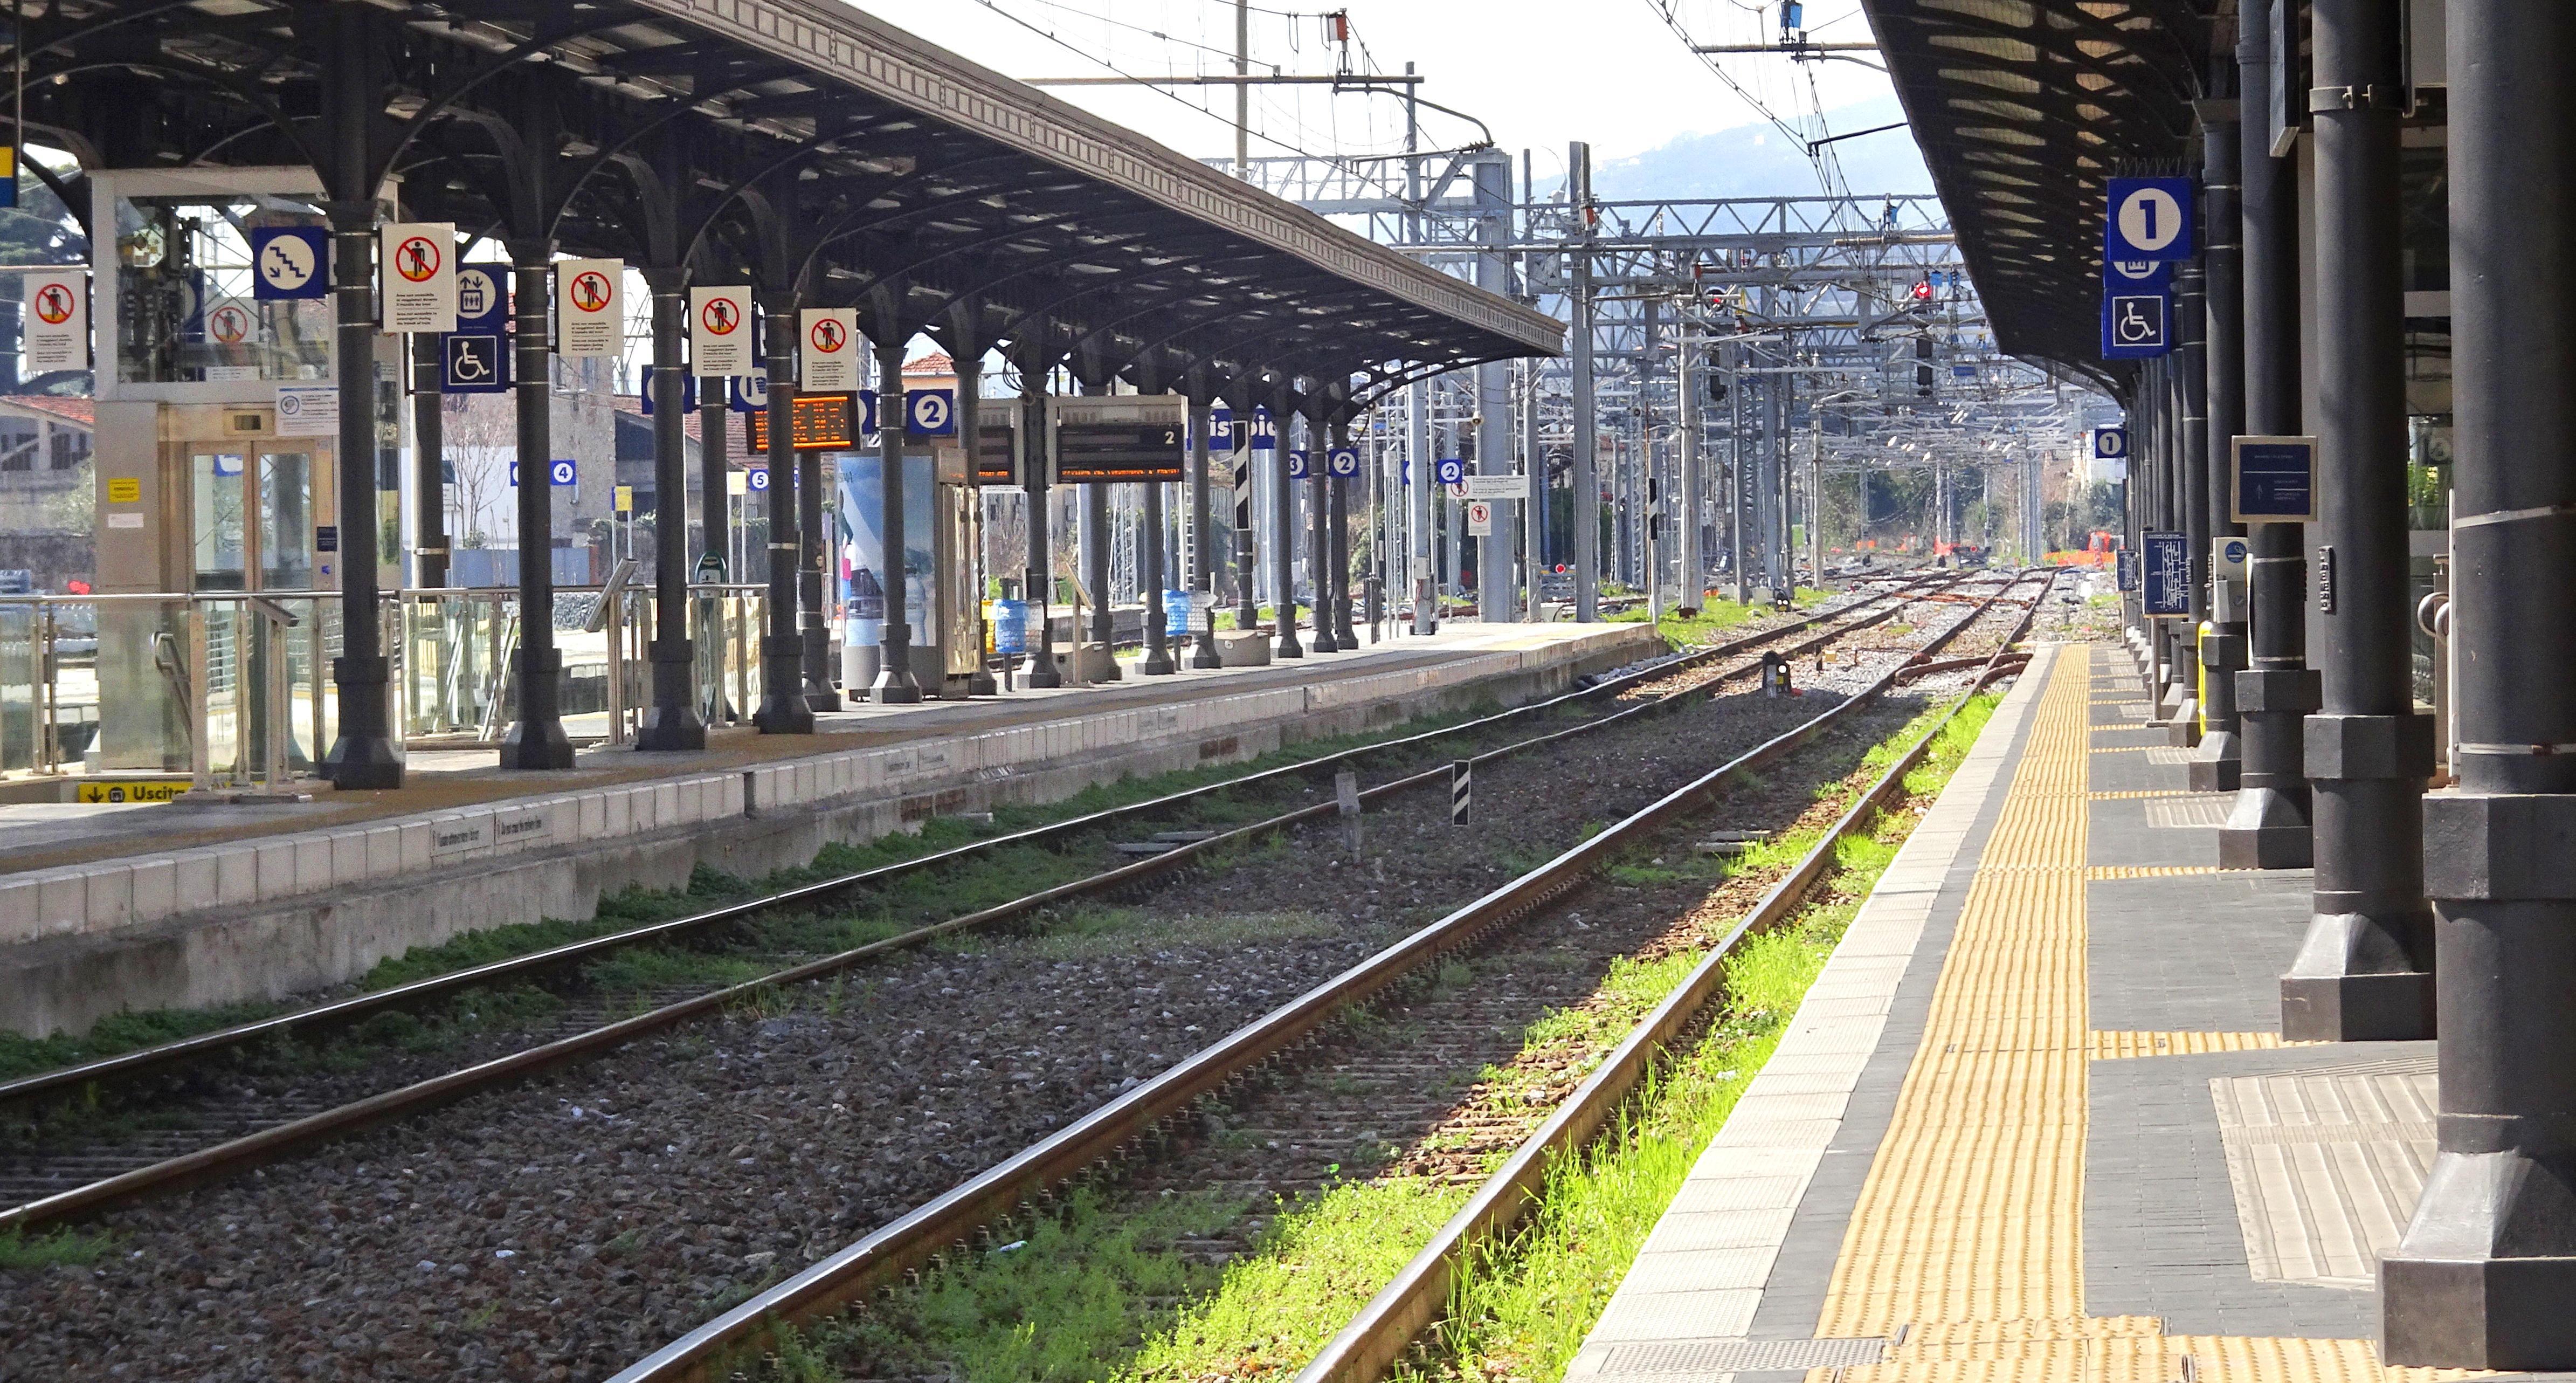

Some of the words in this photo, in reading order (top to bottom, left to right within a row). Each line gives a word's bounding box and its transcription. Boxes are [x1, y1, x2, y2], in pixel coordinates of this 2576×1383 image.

[2139, 199, 2157, 239] 1
[923, 400, 940, 422] 2
[1210, 415, 1276, 437] isia
[1164, 431, 1175, 444] 2
[2106, 436, 2113, 451] 1
[1290, 457, 1298, 472] 3
[1339, 456, 1350, 471] 2
[1446, 465, 1455, 477] 2
[558, 466, 568, 479] 4
[757, 474, 764, 485] 5
